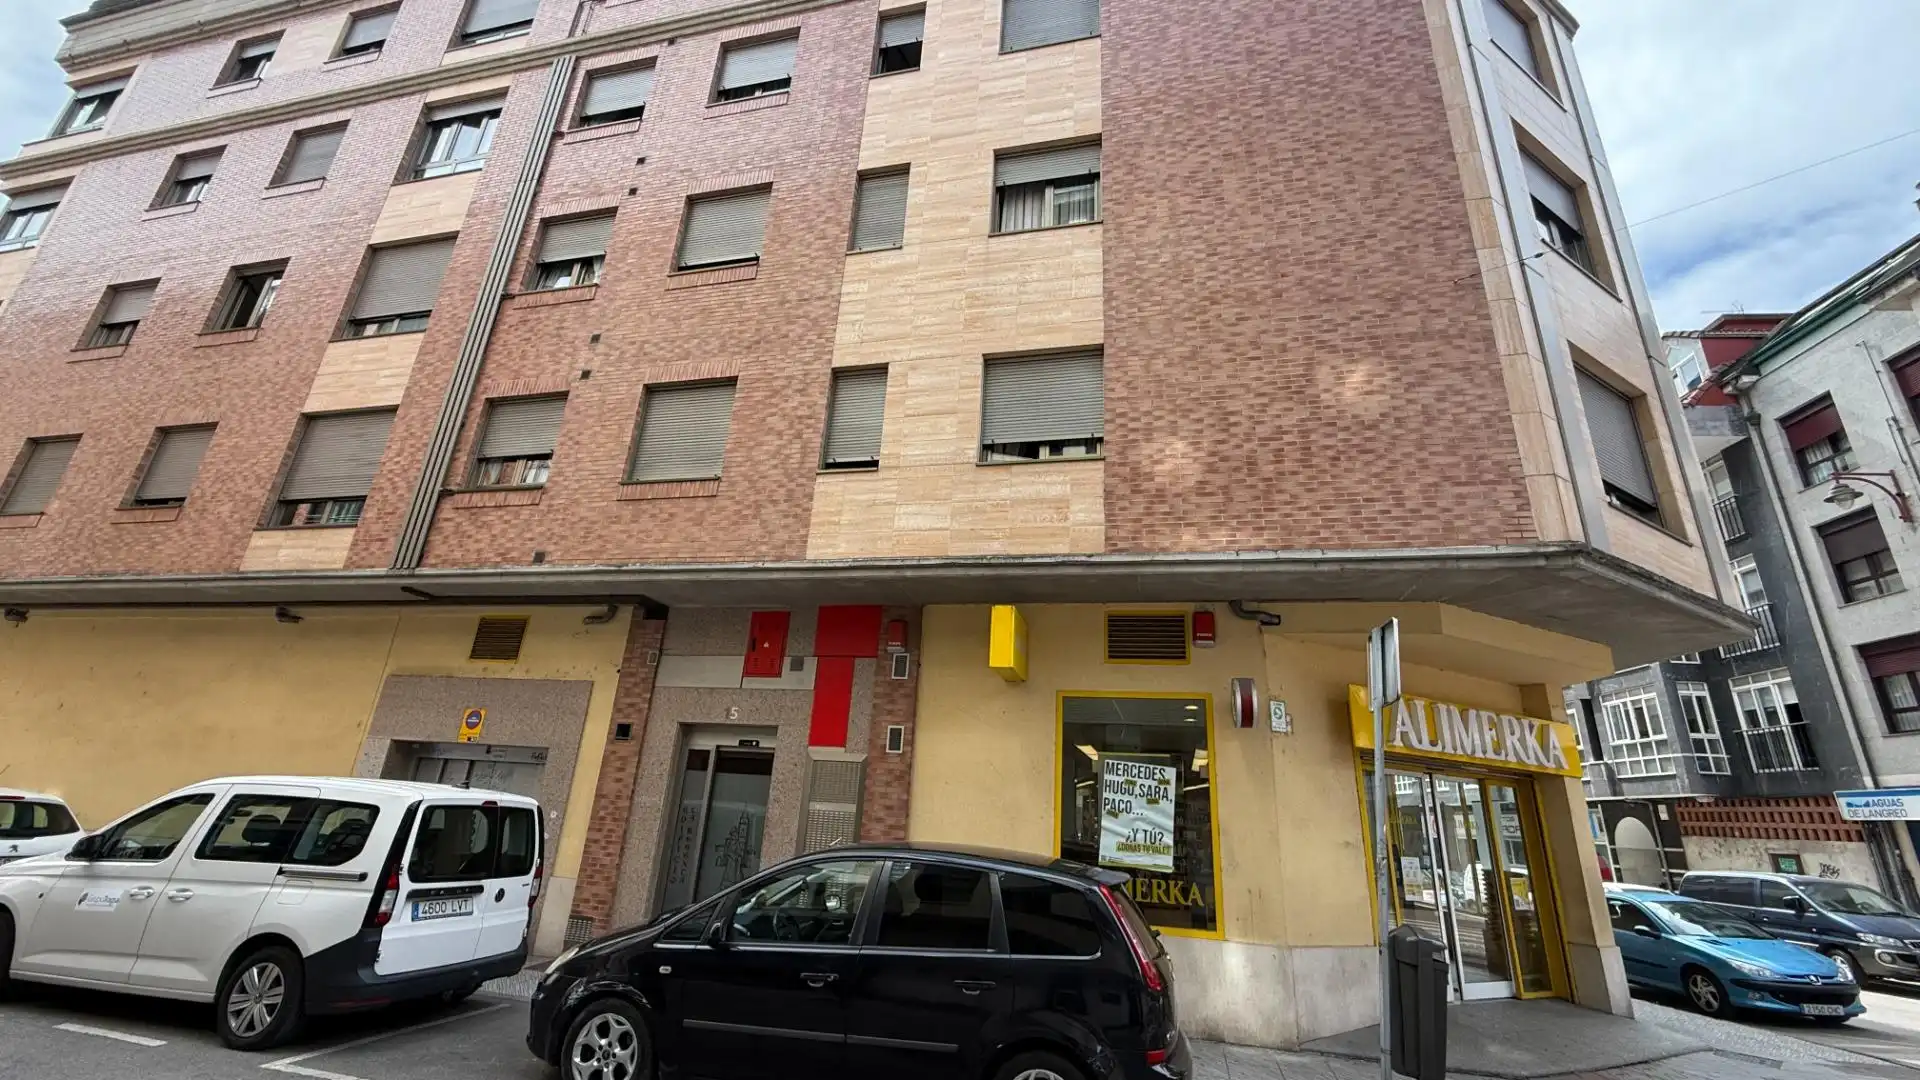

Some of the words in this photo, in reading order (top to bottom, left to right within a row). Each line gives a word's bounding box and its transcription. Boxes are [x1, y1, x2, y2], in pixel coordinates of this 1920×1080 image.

[729, 707, 739, 719] 5
[1390, 695, 1569, 769] ALIMERKA
[1871, 798, 1904, 807] AGUAS
[1848, 809, 1861, 818] DE
[1862, 809, 1908, 818] LANGREO
[1126, 828, 1139, 843] ¿Y
[1142, 827, 1164, 845] TÚ?
[422, 902, 447, 914] 4600
[451, 900, 469, 912] LVT
